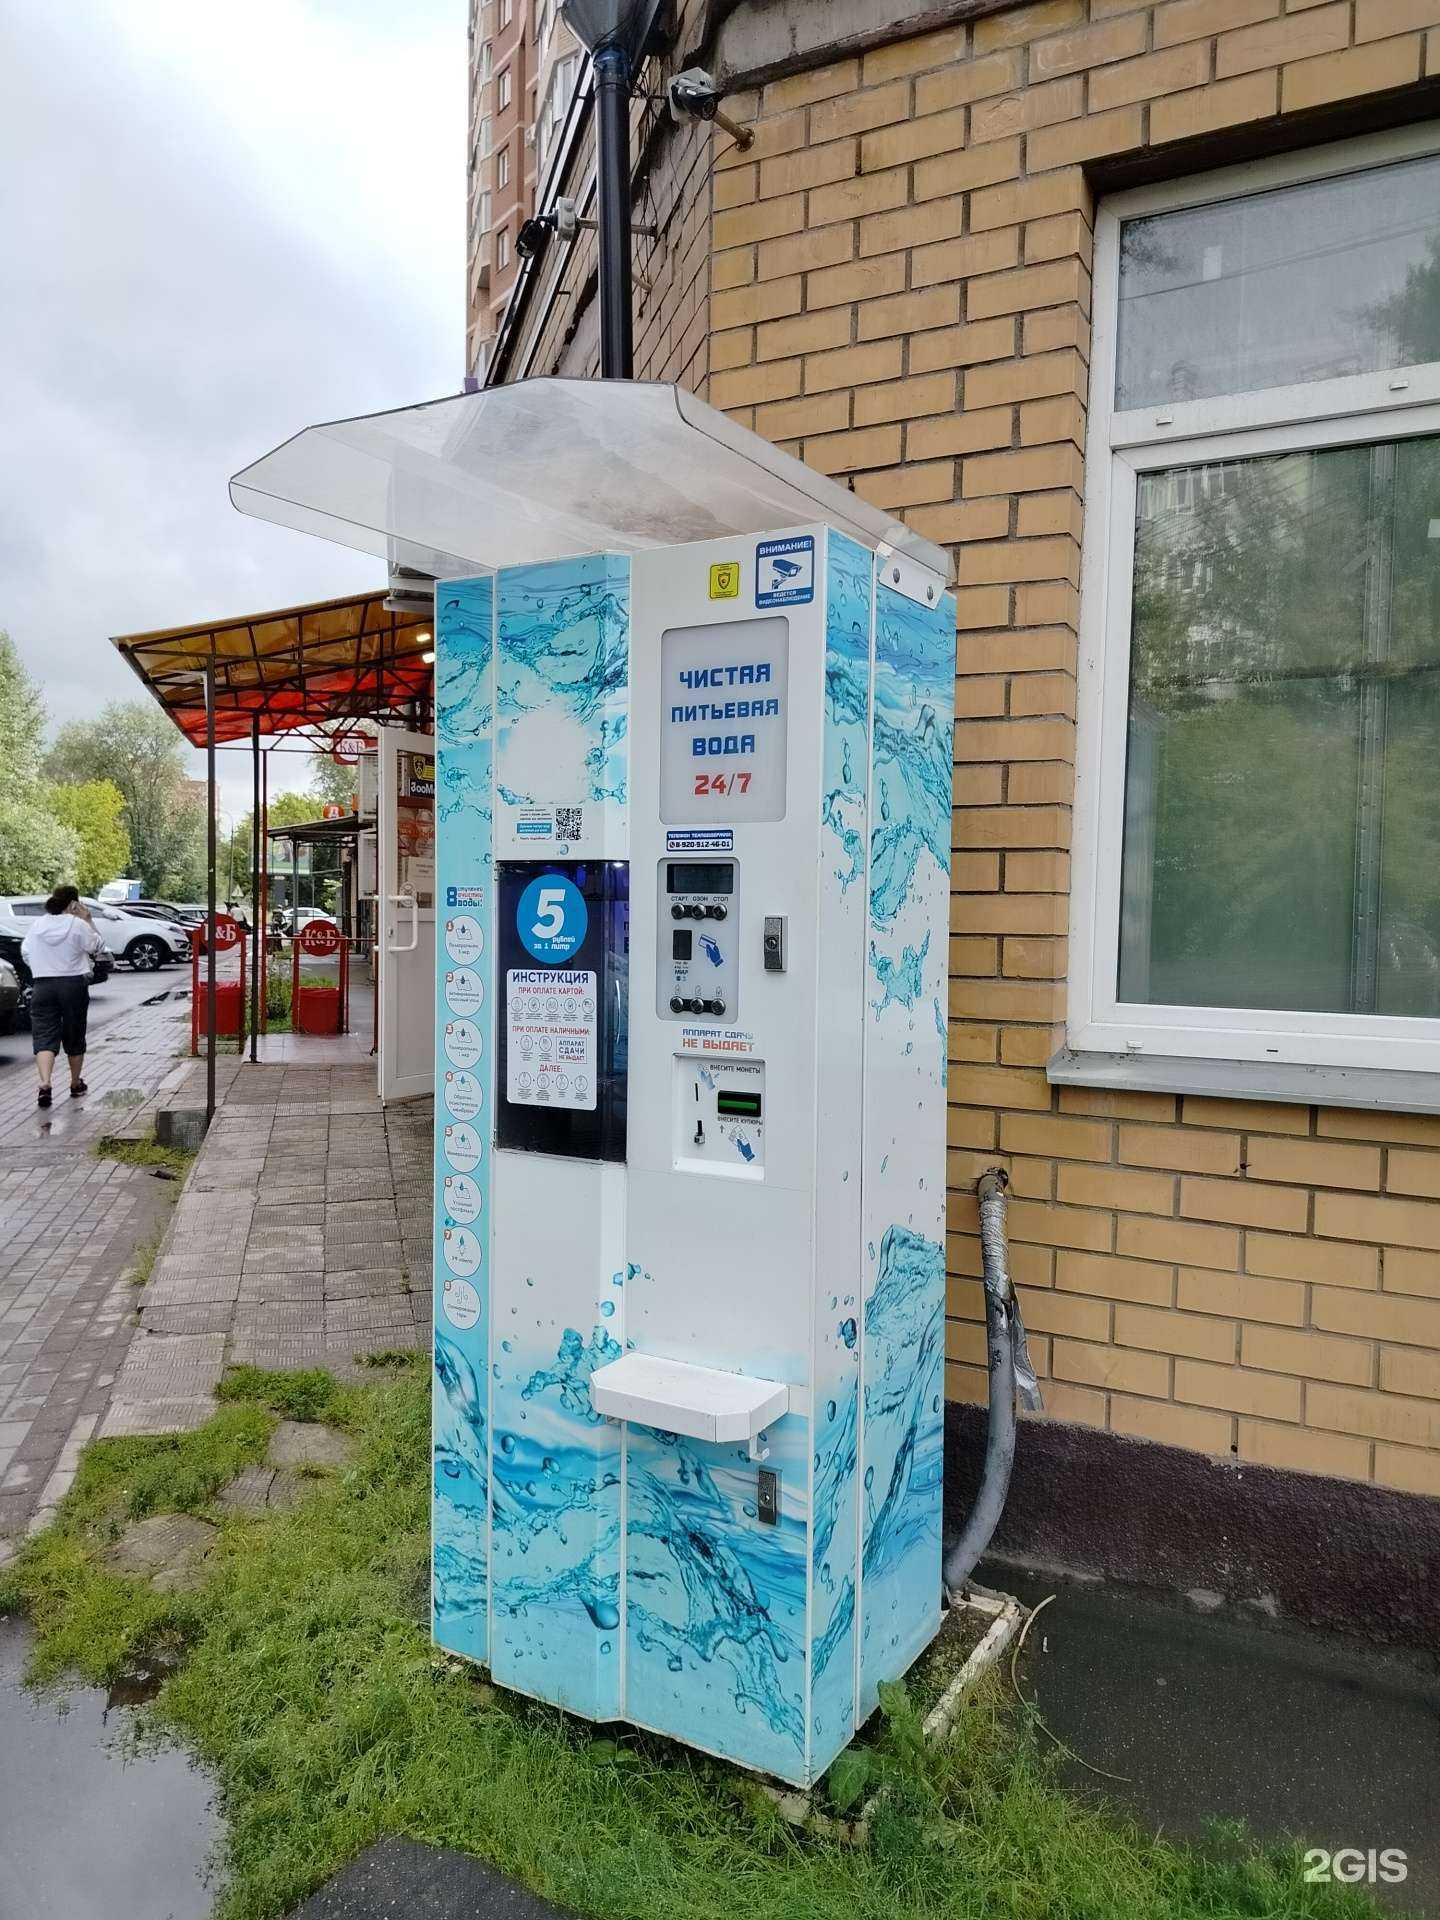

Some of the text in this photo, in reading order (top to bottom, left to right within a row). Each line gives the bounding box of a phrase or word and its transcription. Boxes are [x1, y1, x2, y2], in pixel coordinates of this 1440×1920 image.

[759, 540, 812, 555] ВНИМАНИЕ!
[680, 663, 771, 689] ЧИСТАЯ
[671, 698, 779, 723] ПИТЬЕВАЯ
[692, 735, 756, 756] ВОДА
[694, 772, 752, 796] 24/7
[446, 886, 458, 907] 8
[531, 889, 566, 939] 5
[304, 928, 336, 947] К&Б
[512, 972, 589, 985] ИНСТРУКЦИЯ
[532, 986, 558, 995] ОПЛАТЕ
[525, 1026, 548, 1034] ОПЛАТЕ
[682, 1028, 722, 1038] АППАРАТ
[559, 1046, 585, 1055] СДАЧИ
[682, 1038, 754, 1052] НЕ ВЫДАЕТ
[709, 1064, 761, 1074] ВНЕСИТЕ МОНЕТЫ
